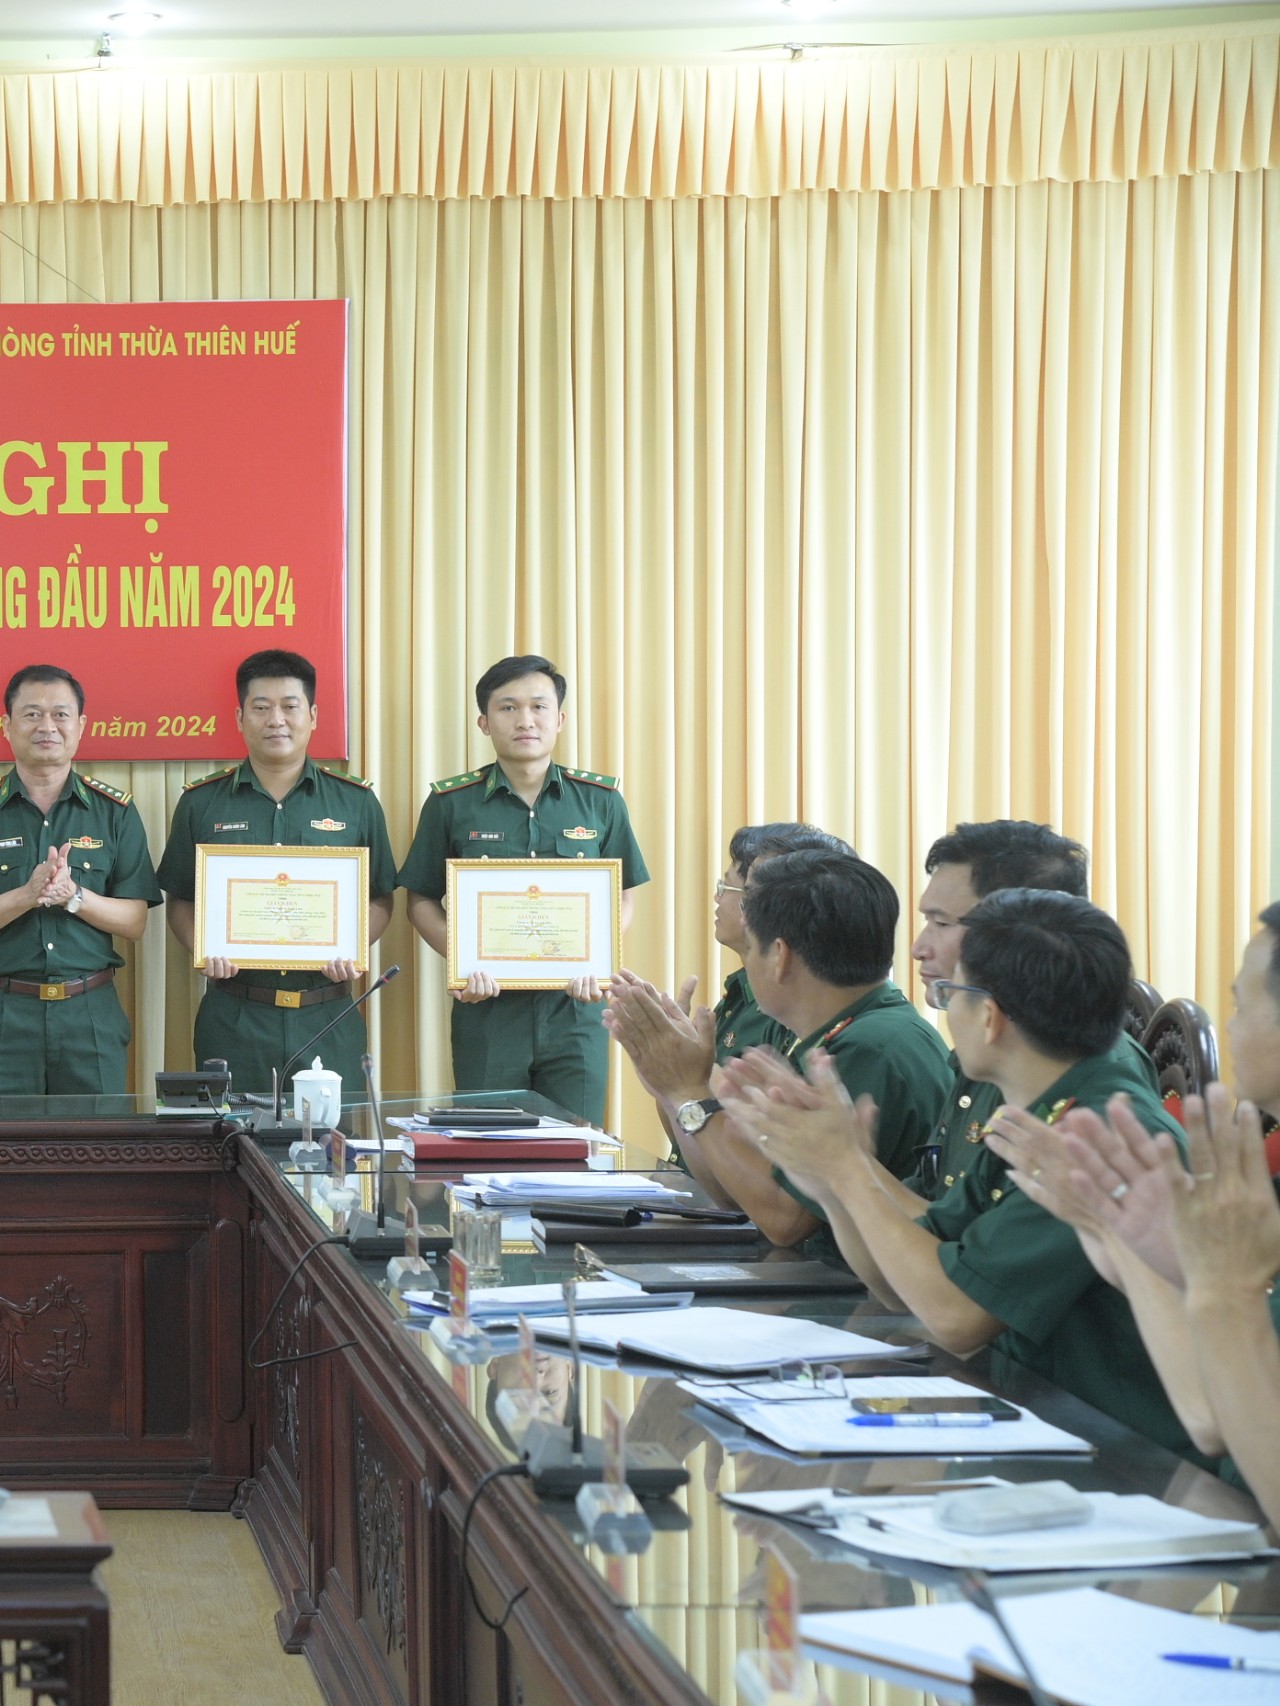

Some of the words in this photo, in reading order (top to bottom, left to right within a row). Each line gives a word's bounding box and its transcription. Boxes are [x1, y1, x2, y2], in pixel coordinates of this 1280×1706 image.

[62, 324, 113, 357] TỈNH
[118, 325, 179, 357] THỪA
[184, 325, 247, 356] THIÊN
[254, 320, 301, 356] HUẾ
[37, 543, 108, 629] ĐẦU
[119, 550, 201, 629] NĂM
[211, 564, 297, 628] 2024
[91, 715, 147, 738] năm
[156, 715, 218, 737] 2024
